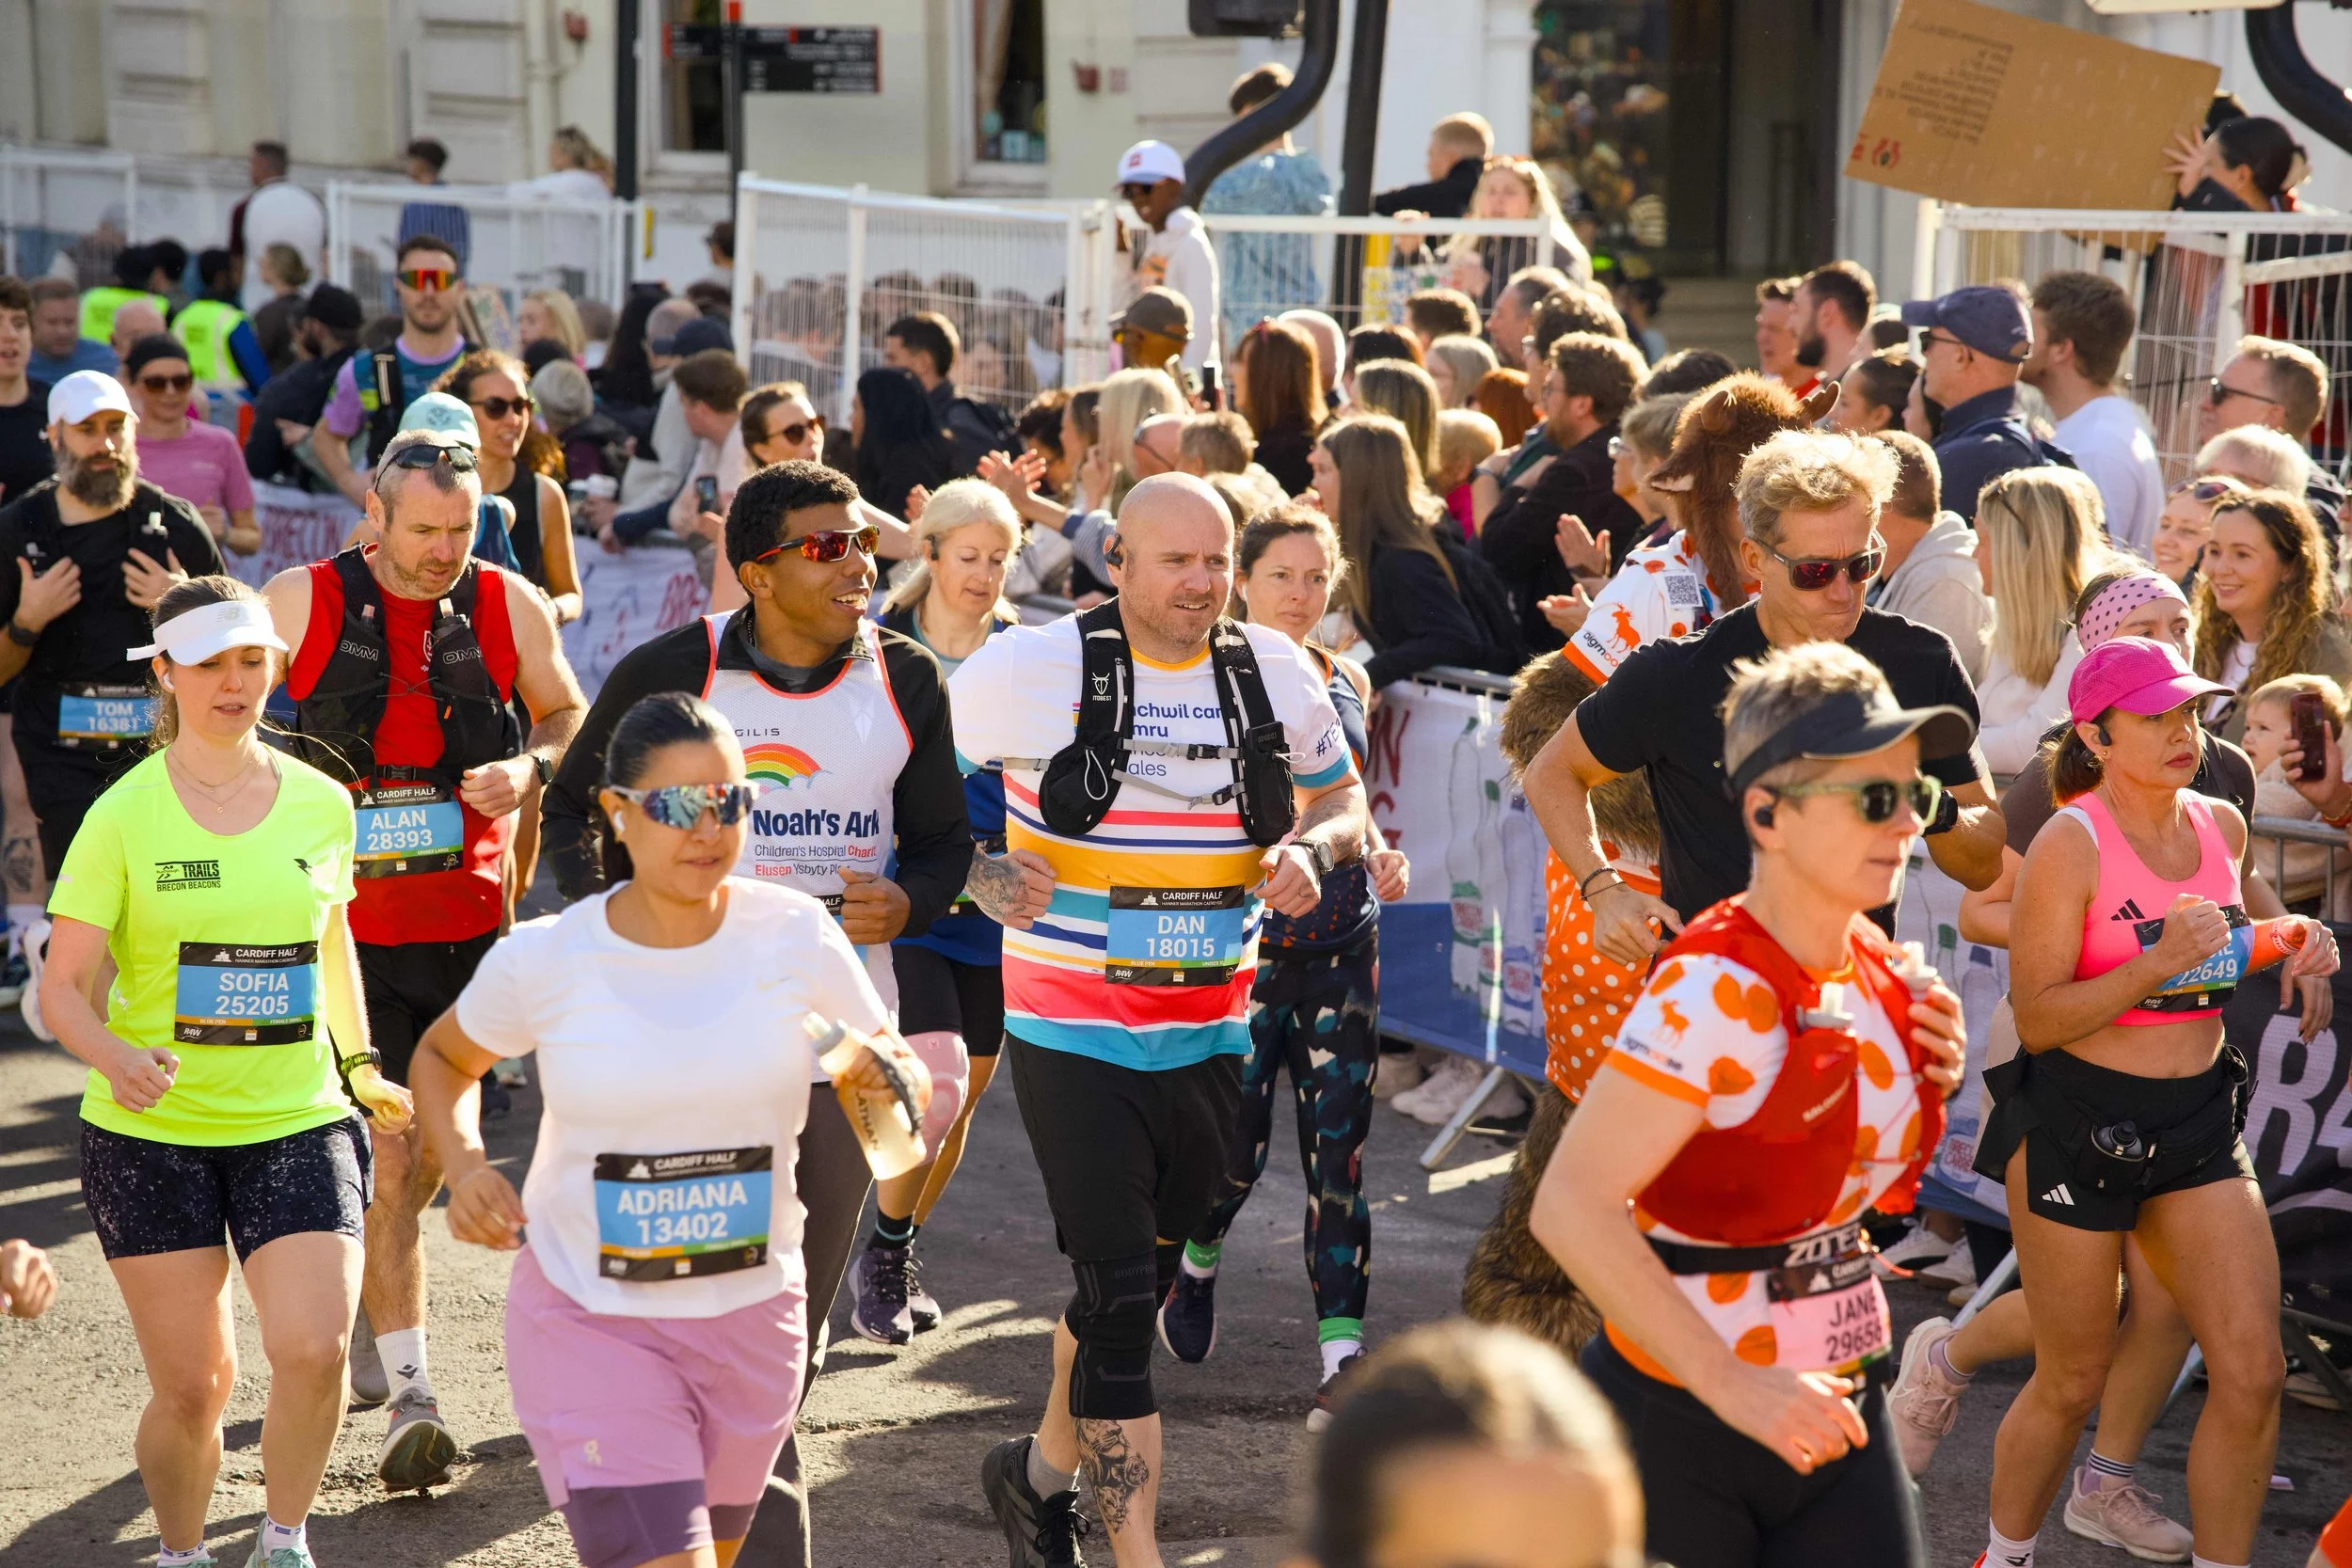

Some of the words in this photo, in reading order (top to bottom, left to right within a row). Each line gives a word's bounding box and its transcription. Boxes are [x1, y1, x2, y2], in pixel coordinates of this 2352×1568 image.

[340, 640, 378, 661] OMM
[1582, 630, 1619, 668] bigmoo
[95, 701, 134, 717] TOM
[88, 717, 139, 732] 16381
[1128, 760, 1167, 776] ales
[377, 788, 414, 800] CARDIFF
[414, 786, 437, 797] HALF
[371, 810, 427, 830] ALAN
[753, 808, 840, 836] Noah's
[844, 809, 880, 838] Ark
[367, 830, 433, 851] 28393
[755, 845, 806, 857] Children's
[808, 845, 847, 858] Hospital
[182, 863, 220, 878] TRAILS
[755, 864, 792, 876] Elusen
[793, 863, 828, 876] Ysbyty
[157, 882, 186, 892] BRECON
[188, 880, 221, 890] BEACONS
[1162, 892, 1200, 901] CARDIFF
[1202, 891, 1223, 900] HALF
[1158, 915, 1205, 934] DAN
[235, 948, 278, 958] CARDIFF
[278, 947, 298, 958] HALF
[1146, 938, 1215, 958] 18015
[2177, 958, 2237, 986] 22649
[218, 973, 290, 992] SOFIA
[215, 995, 290, 1016] 25205
[654, 1154, 705, 1171] CARDIFF
[707, 1151, 738, 1165] HALF
[617, 1180, 748, 1216] ADRIANA
[636, 1212, 729, 1245] 13402
[1829, 1288, 1877, 1327] JANE
